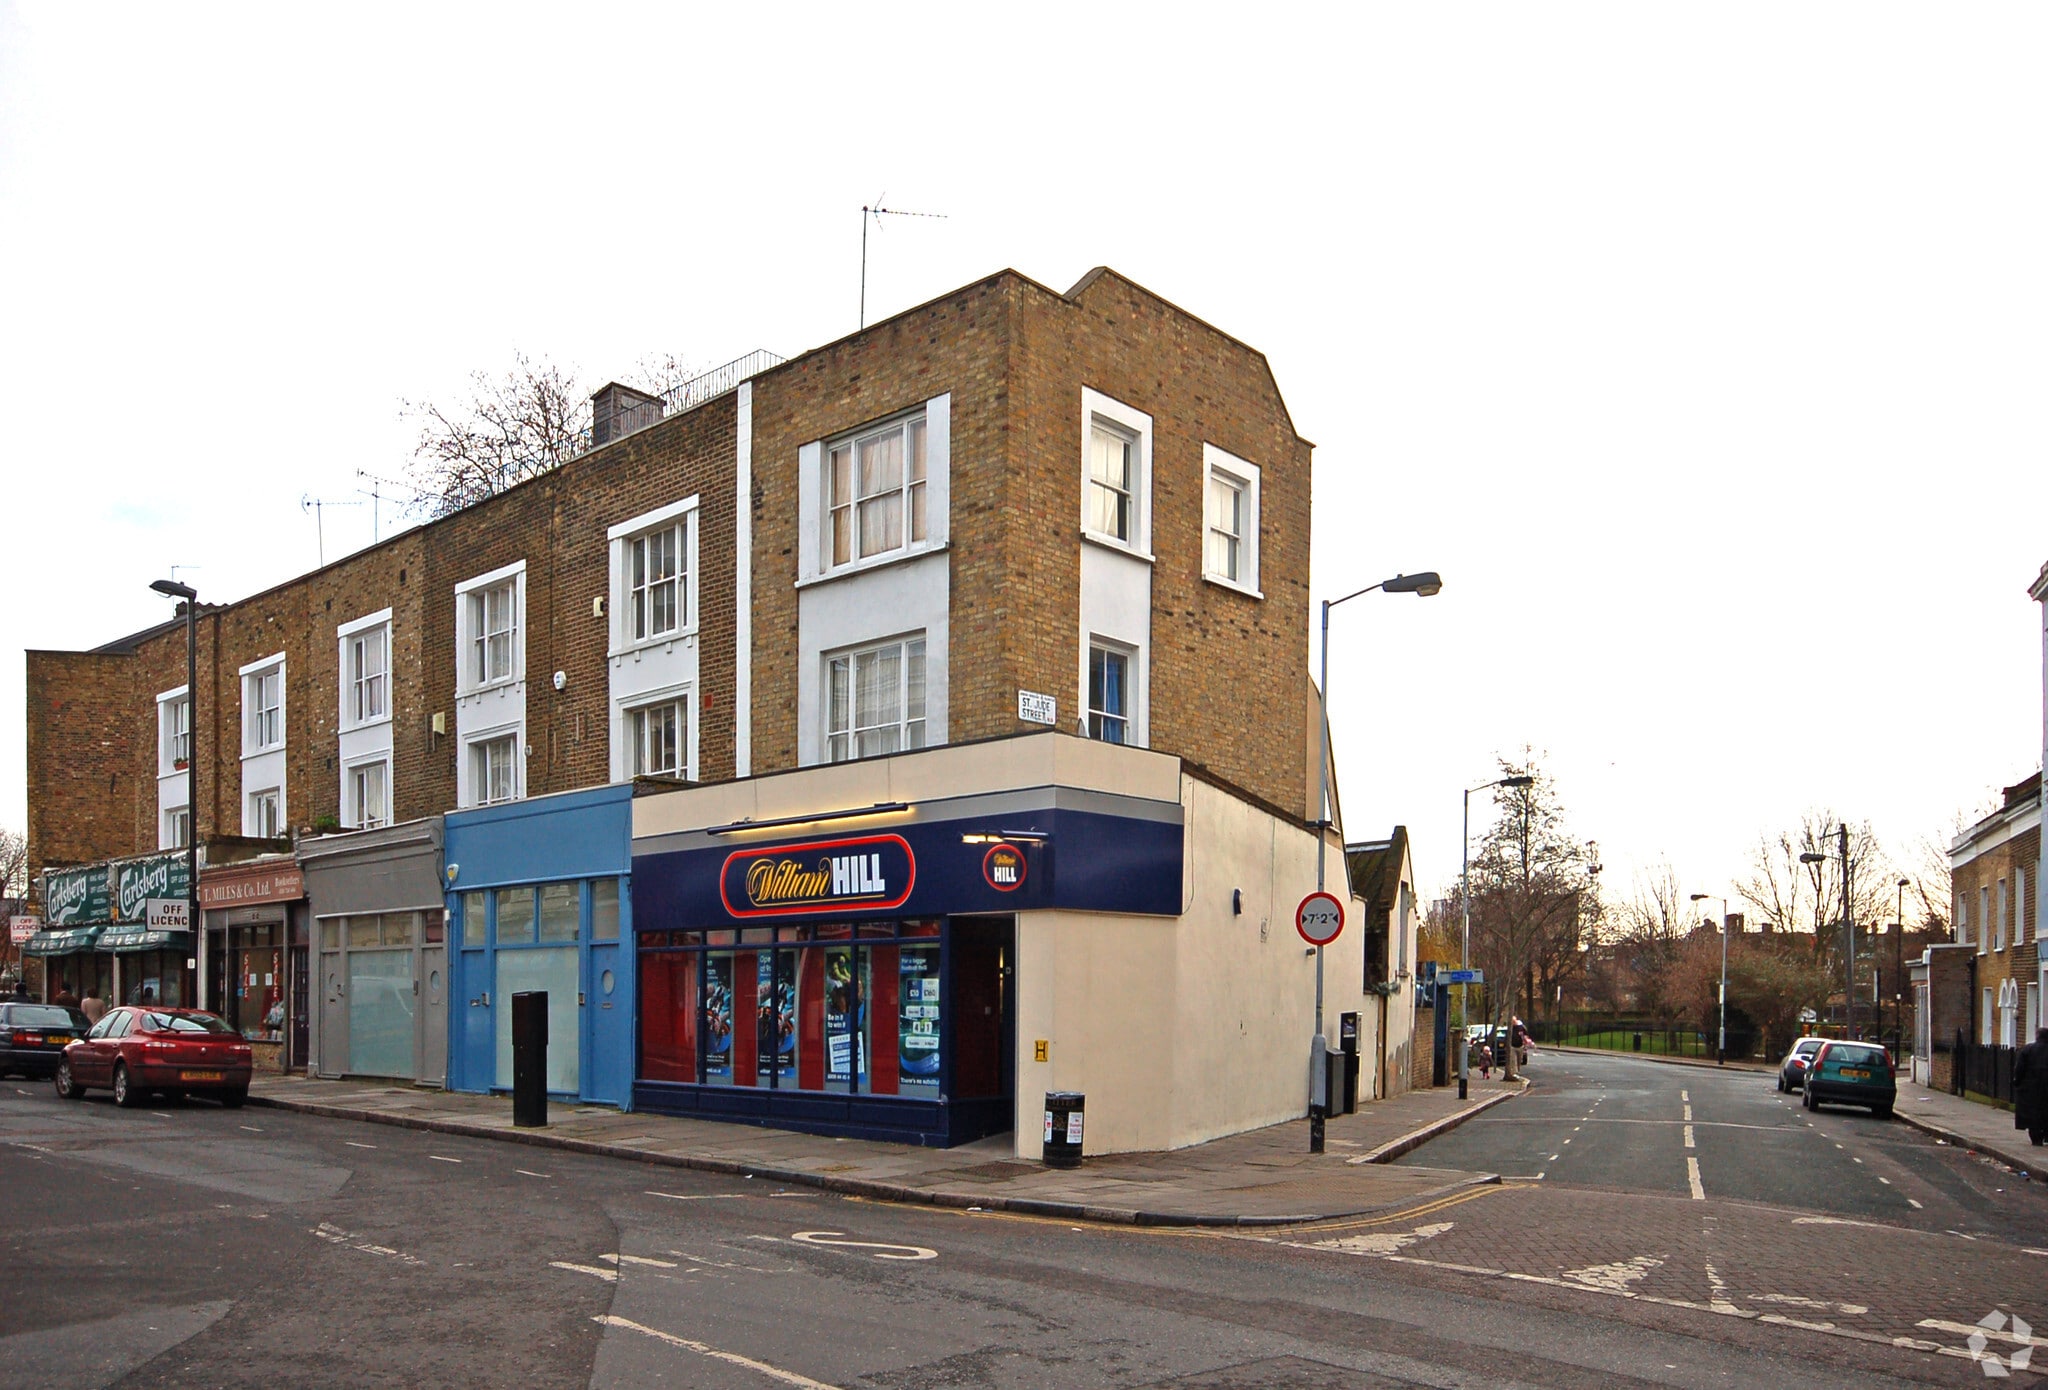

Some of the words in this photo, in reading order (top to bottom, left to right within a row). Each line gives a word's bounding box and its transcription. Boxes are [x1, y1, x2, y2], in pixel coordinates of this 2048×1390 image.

[1022, 697, 1032, 707] ST.
[1034, 700, 1050, 712] JUDE
[1022, 708, 1046, 720] STREET
[746, 857, 833, 903] William
[832, 853, 886, 895] HILL
[994, 866, 1017, 882] HILL
[47, 875, 87, 922] Carlsberg
[120, 863, 168, 917] Carlsberg
[204, 888, 211, 902] T.
[212, 885, 236, 901] MILES
[236, 885, 243, 899] &
[244, 882, 255, 898] Co.
[256, 881, 271, 896] Ltd.
[163, 904, 183, 914] OFF
[151, 916, 188, 926] LICENC
[1036, 1041, 1046, 1060] H
